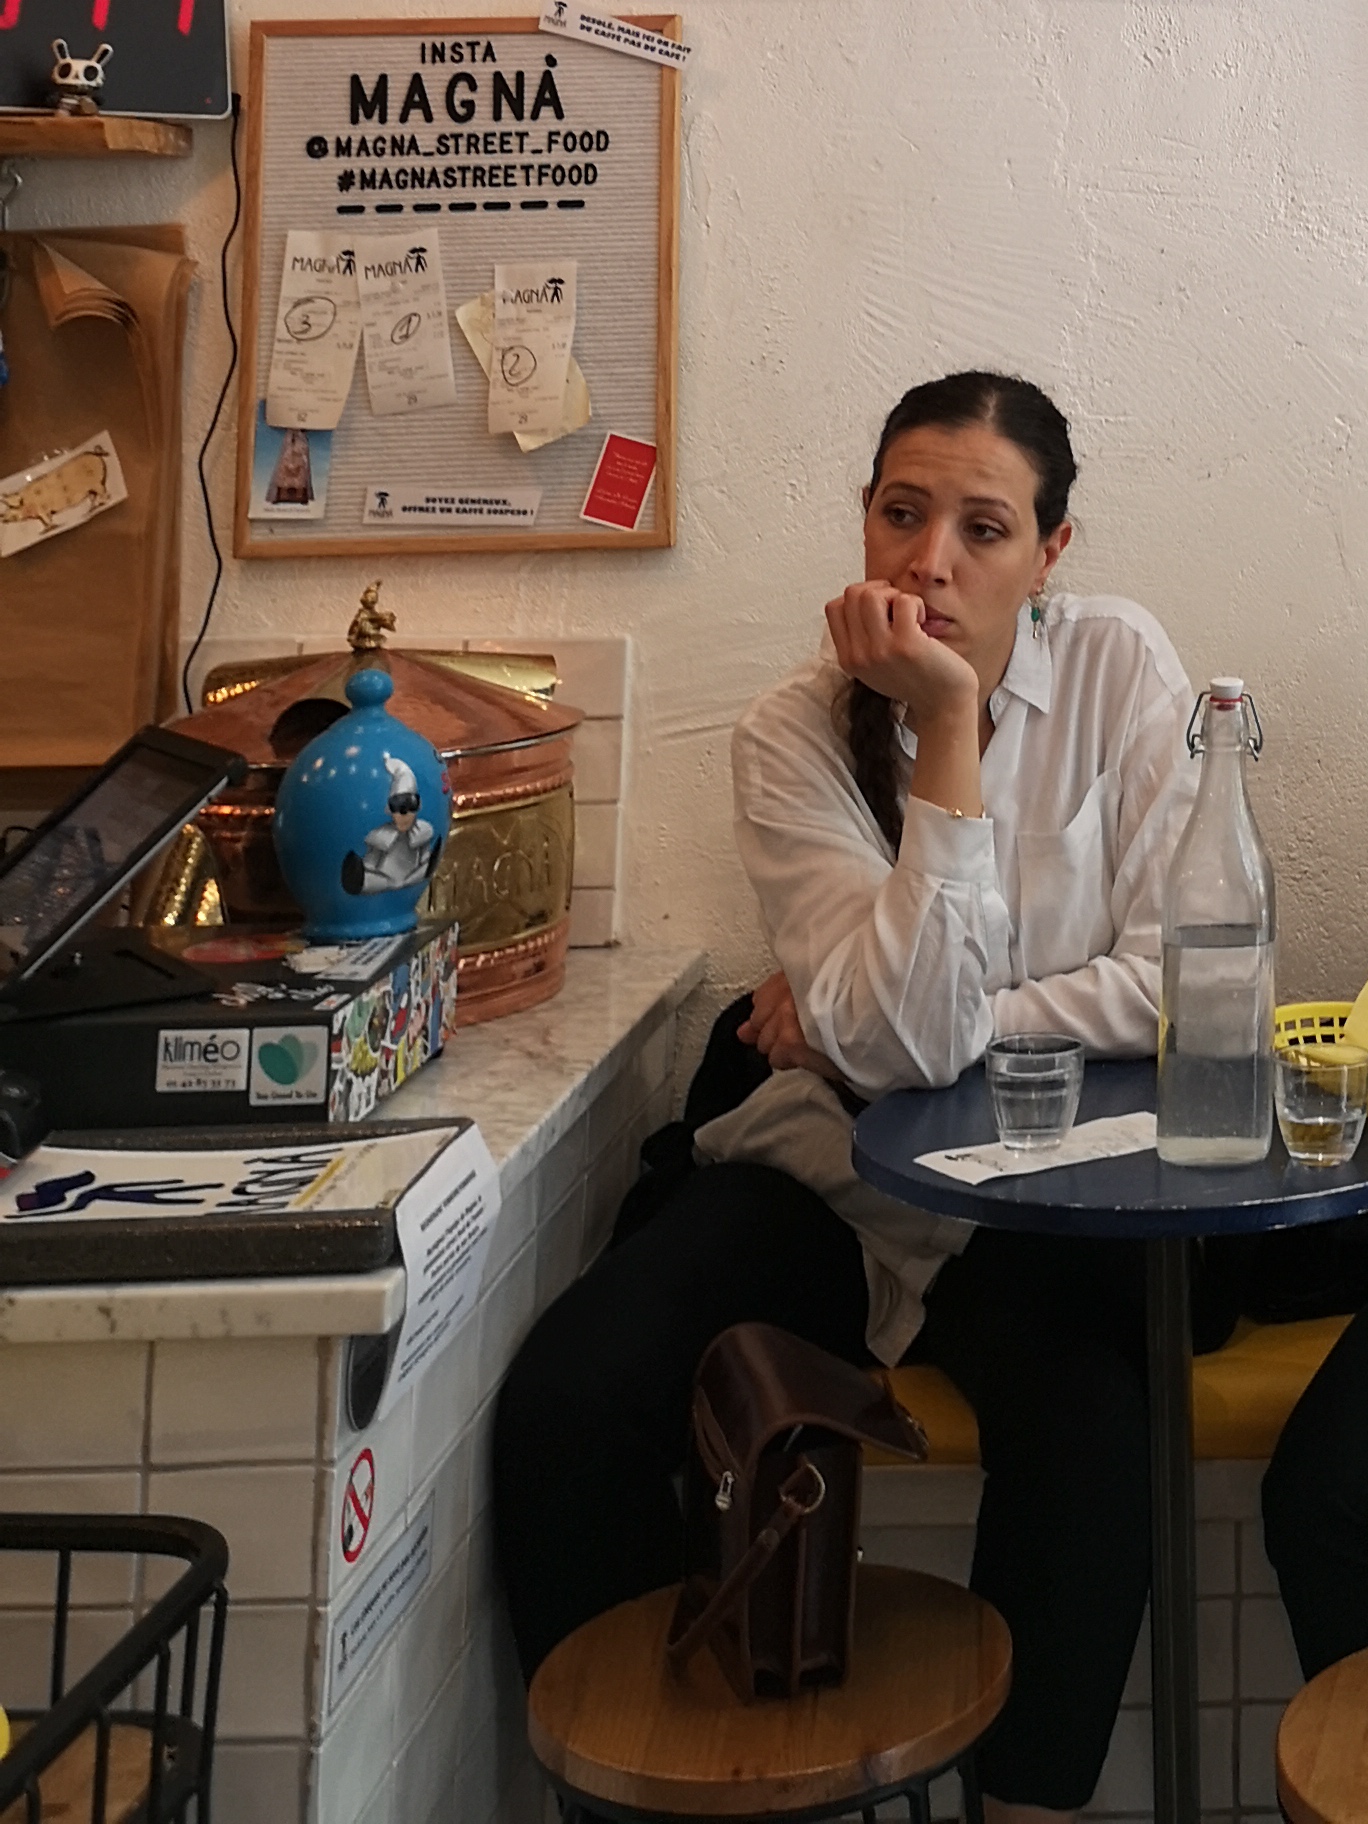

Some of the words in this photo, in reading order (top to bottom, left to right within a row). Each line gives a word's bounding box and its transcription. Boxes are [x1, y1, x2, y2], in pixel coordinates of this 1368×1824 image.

[579, 24, 592, 33] DU
[624, 37, 641, 48] PAS
[644, 44, 656, 52] DU
[617, 26, 640, 38] MAIS
[642, 33, 655, 43] ICI
[657, 38, 669, 47] ON
[671, 43, 692, 54] FAIT
[420, 40, 497, 65] INSTA
[336, 162, 598, 193] #MAGNASTREETFOOD
[402, 505, 436, 513] OFFREZ
[425, 496, 455, 504] SOYEZ
